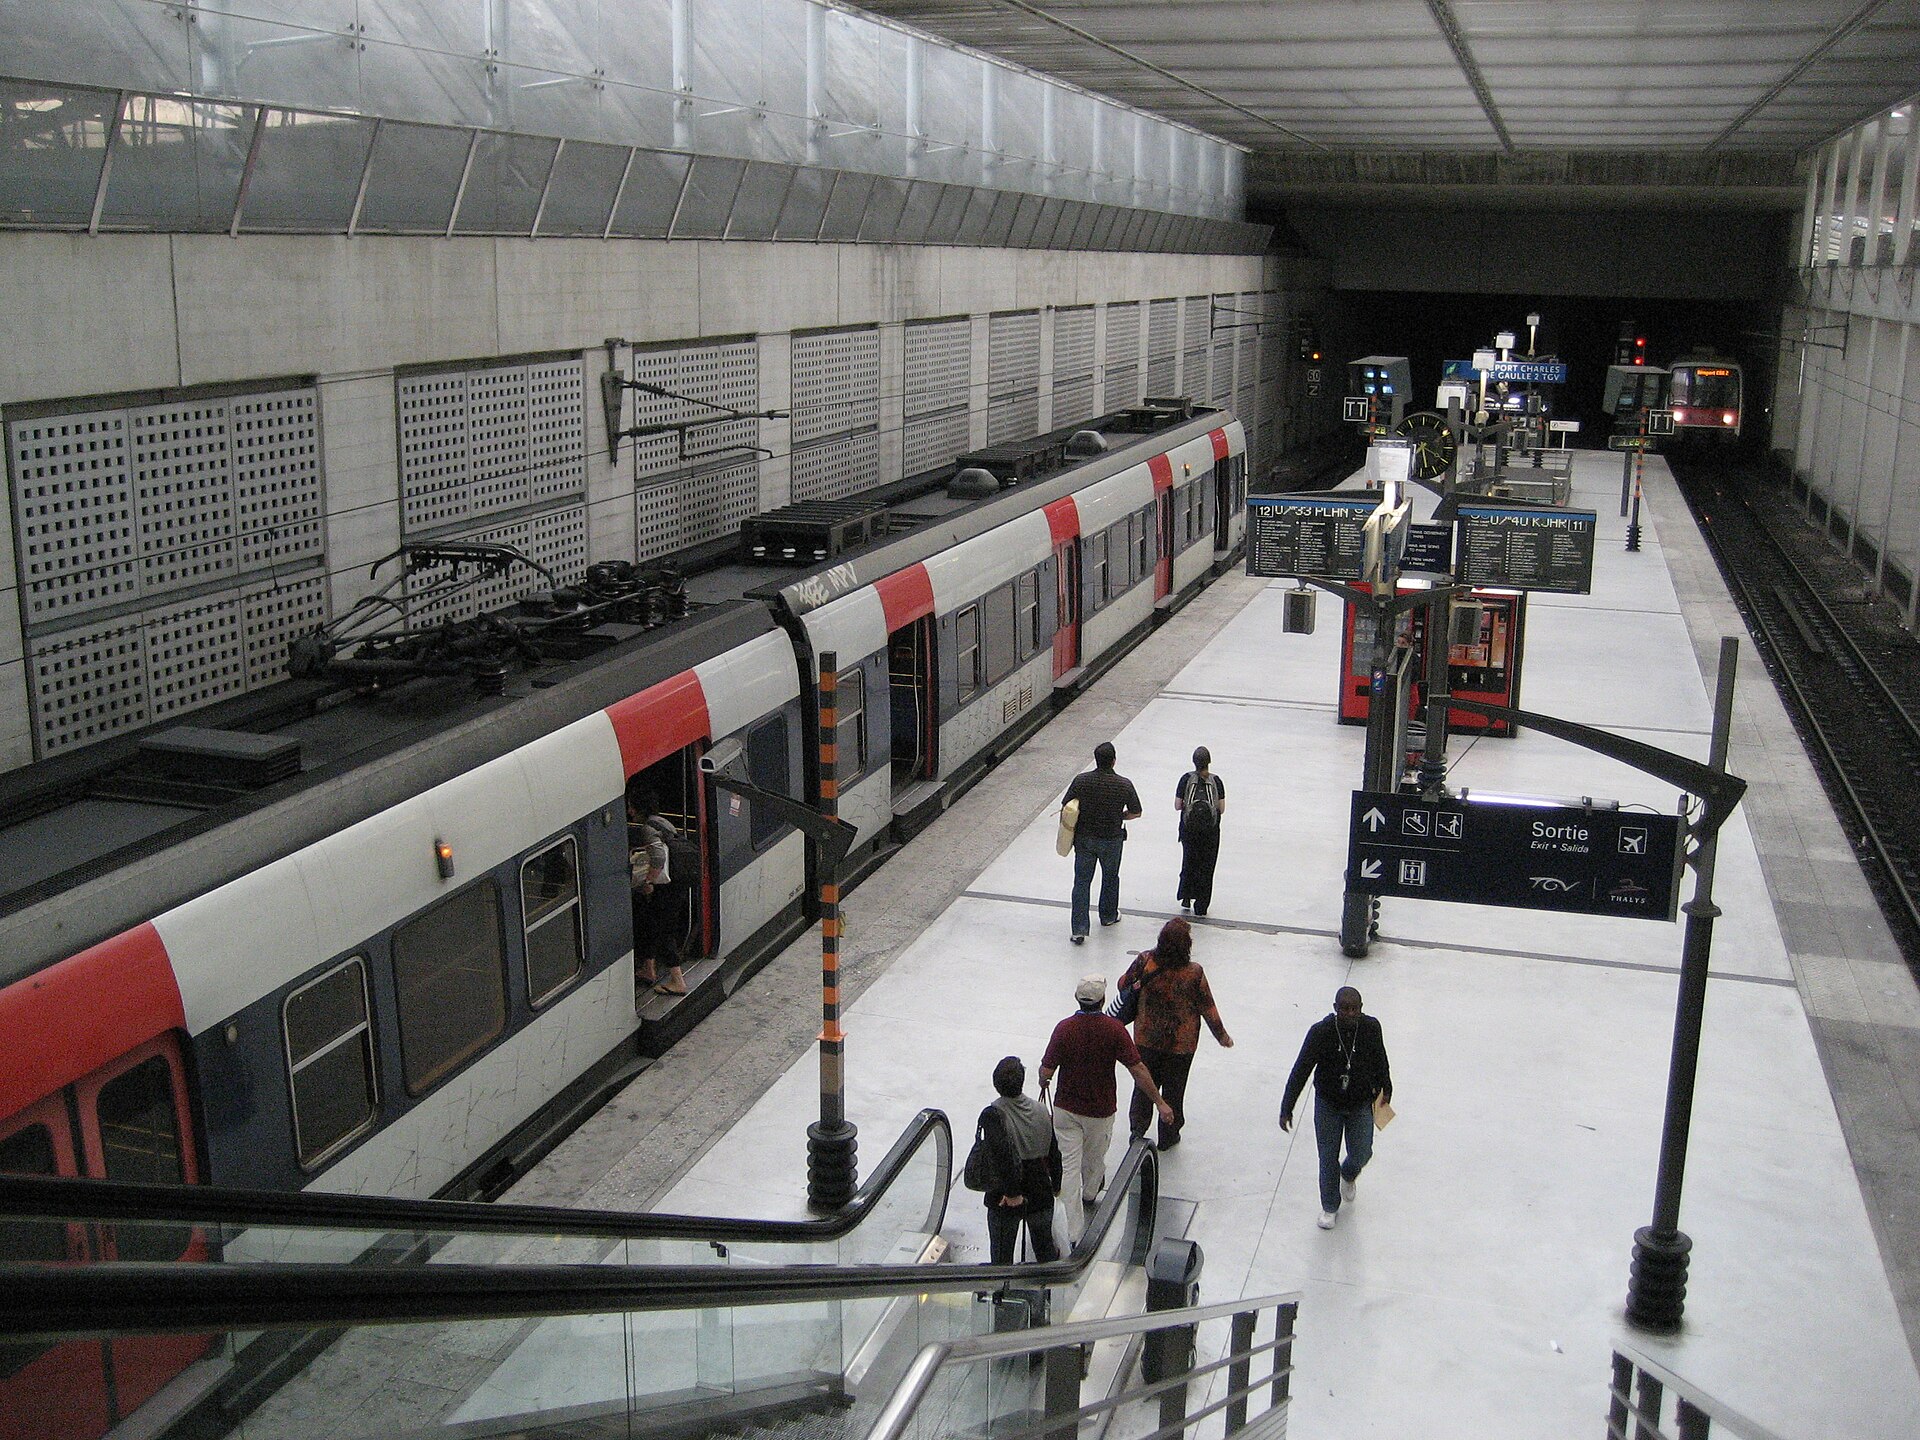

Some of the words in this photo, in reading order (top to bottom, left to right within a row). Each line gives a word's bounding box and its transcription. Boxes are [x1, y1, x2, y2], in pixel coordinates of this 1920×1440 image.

[1520, 364, 1560, 373] CHARLES
[1498, 372, 1532, 380] GAULLE
[1259, 506, 1271, 516] 12
[1573, 521, 1583, 530] 11
[1531, 821, 1589, 841] Sortie
[1530, 840, 1550, 851] Exit
[1560, 842, 1589, 854] Salida
[1610, 895, 1646, 904] THALYS
